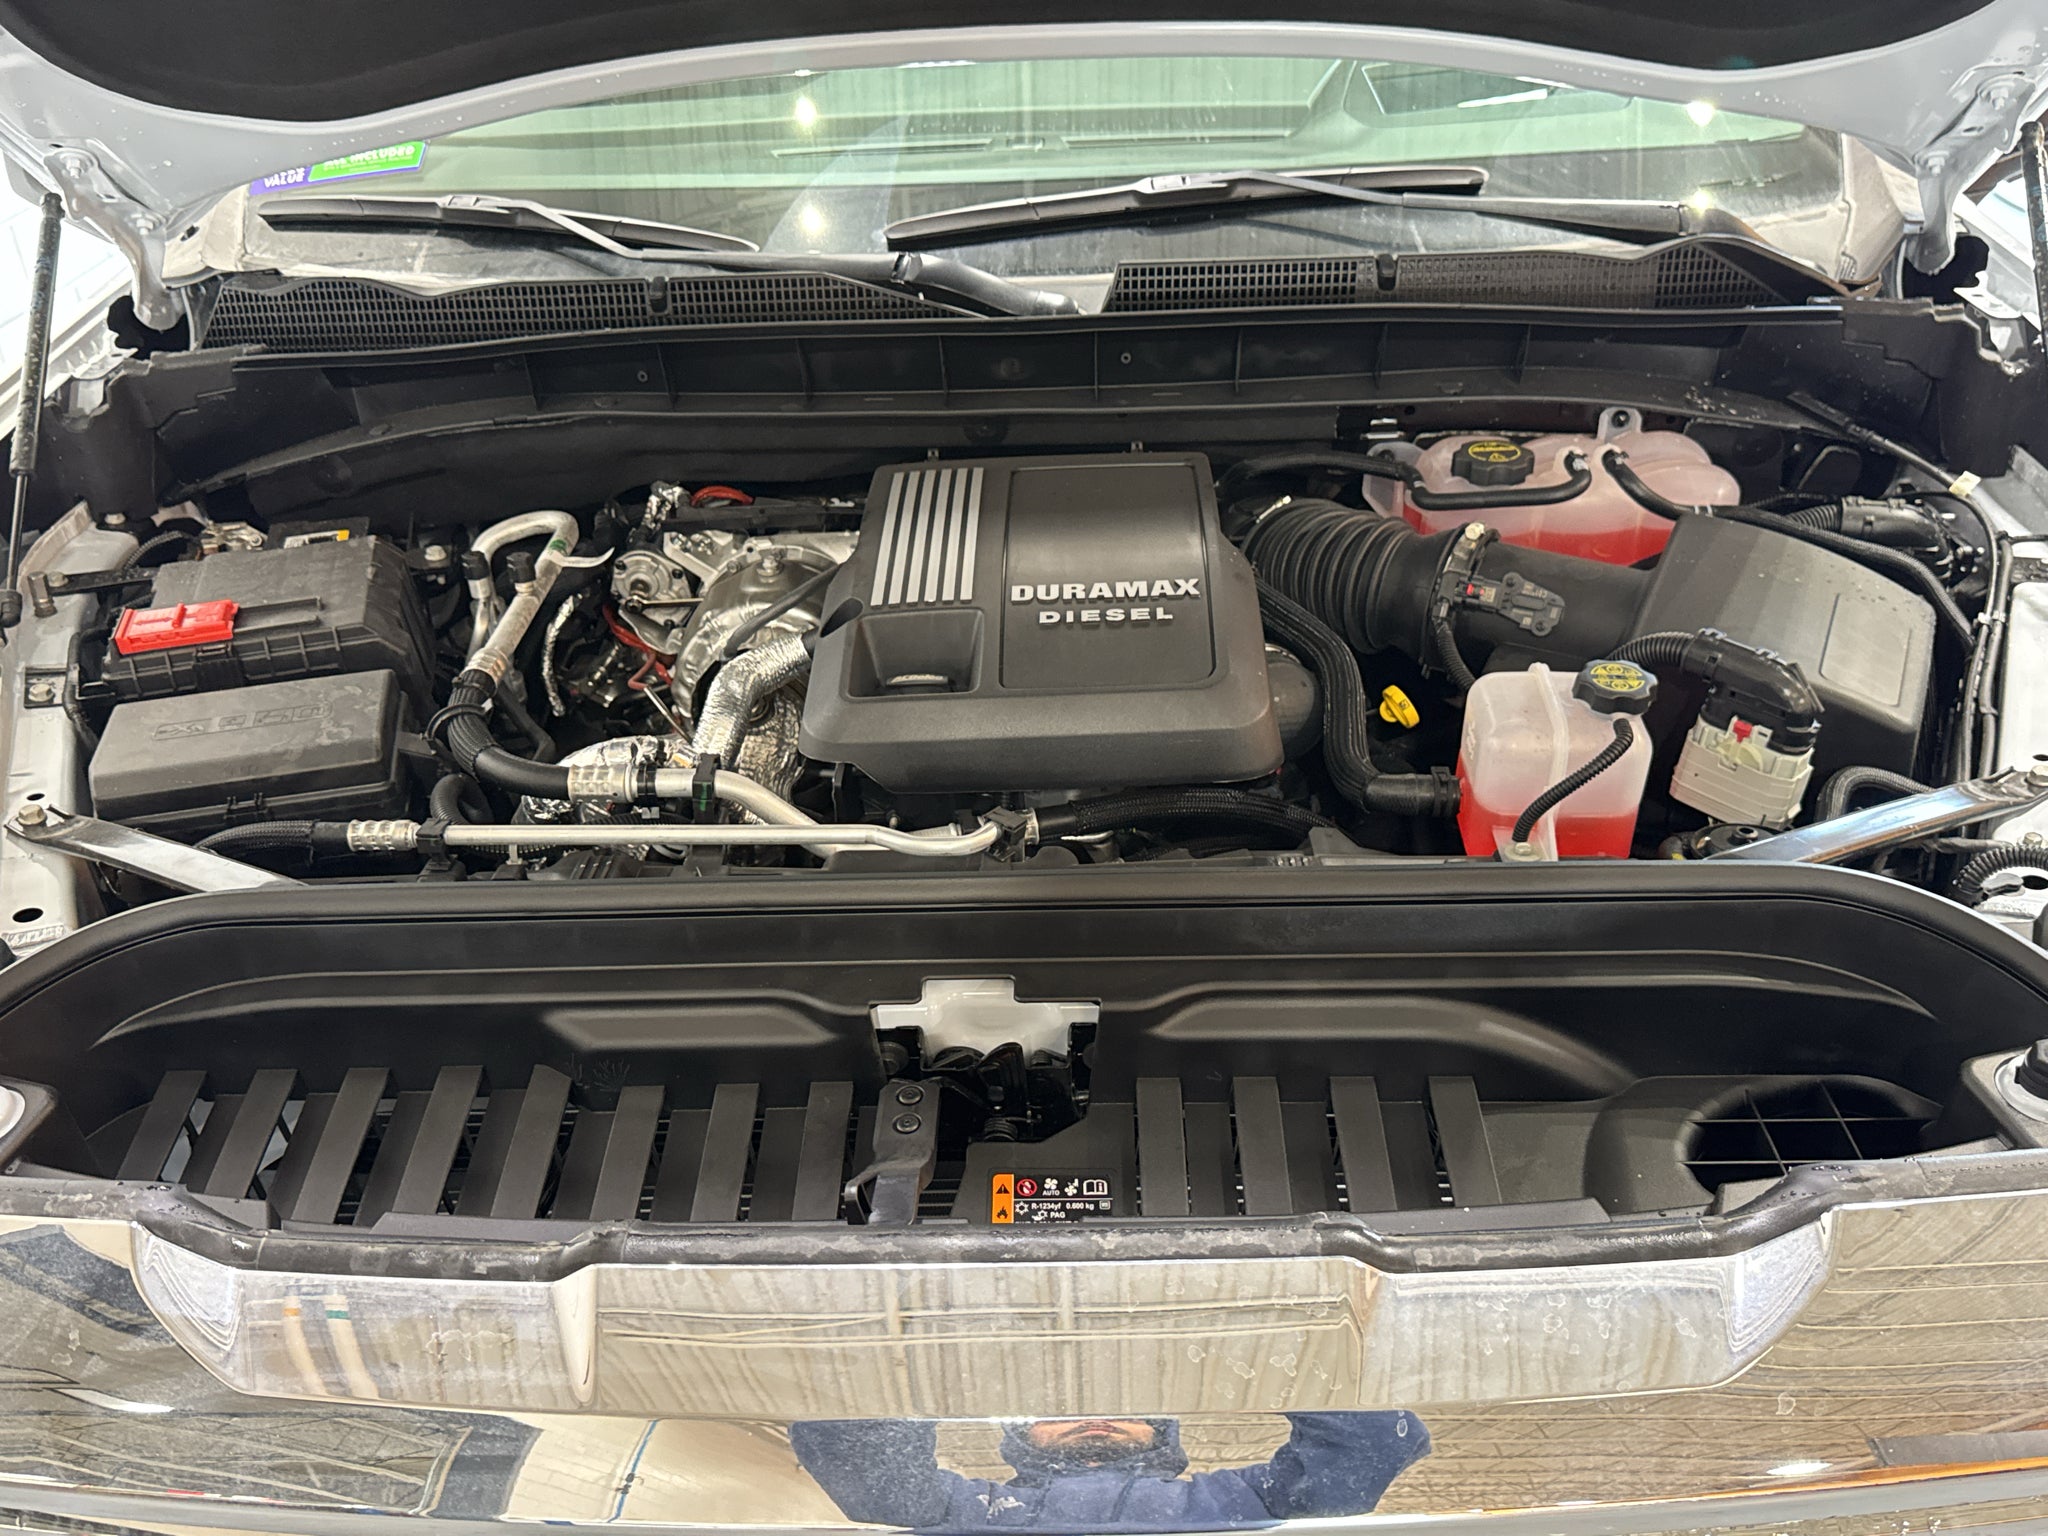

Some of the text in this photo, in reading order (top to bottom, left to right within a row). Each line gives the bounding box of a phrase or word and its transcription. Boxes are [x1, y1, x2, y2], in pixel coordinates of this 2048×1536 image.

[1010, 578, 1200, 602] DURAMAX
[1038, 607, 1174, 624] DIESEL
[1031, 1202, 1062, 1211] R-1234yf
[1085, 1202, 1095, 1211] kg
[1050, 1211, 1066, 1219] PAG
